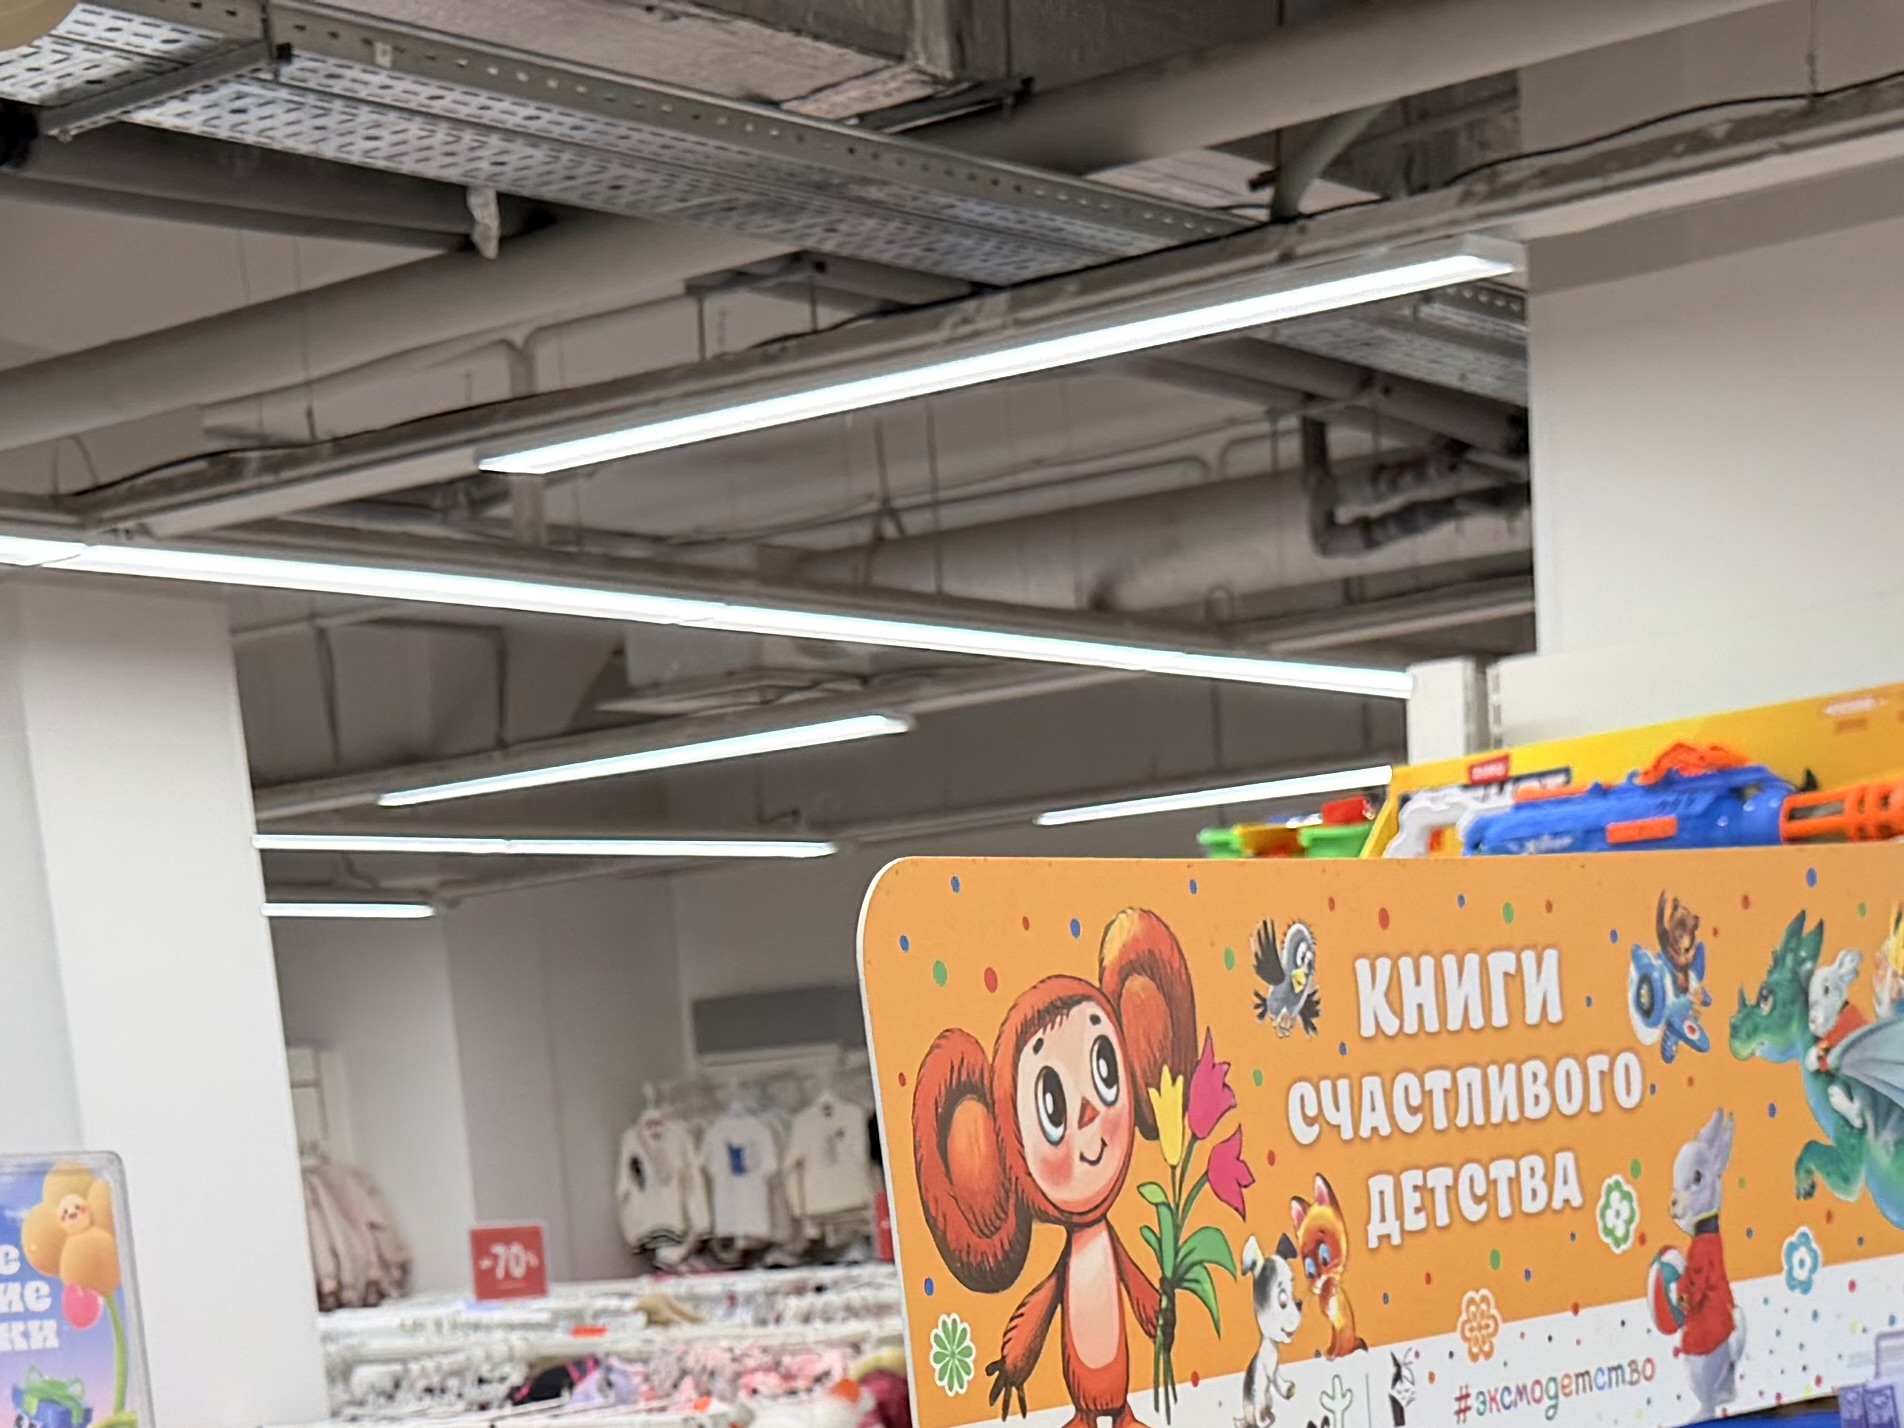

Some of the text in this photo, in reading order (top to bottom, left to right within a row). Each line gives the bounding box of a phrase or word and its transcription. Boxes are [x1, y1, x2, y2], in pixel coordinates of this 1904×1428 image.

[1354, 947, 1564, 1039] КНИГИ
[1285, 1050, 1645, 1148] СЧАСТЛИВОГО
[1364, 1148, 1584, 1251] ДЕТСТВА
[1453, 1356, 1658, 1425] #эксмодетство
